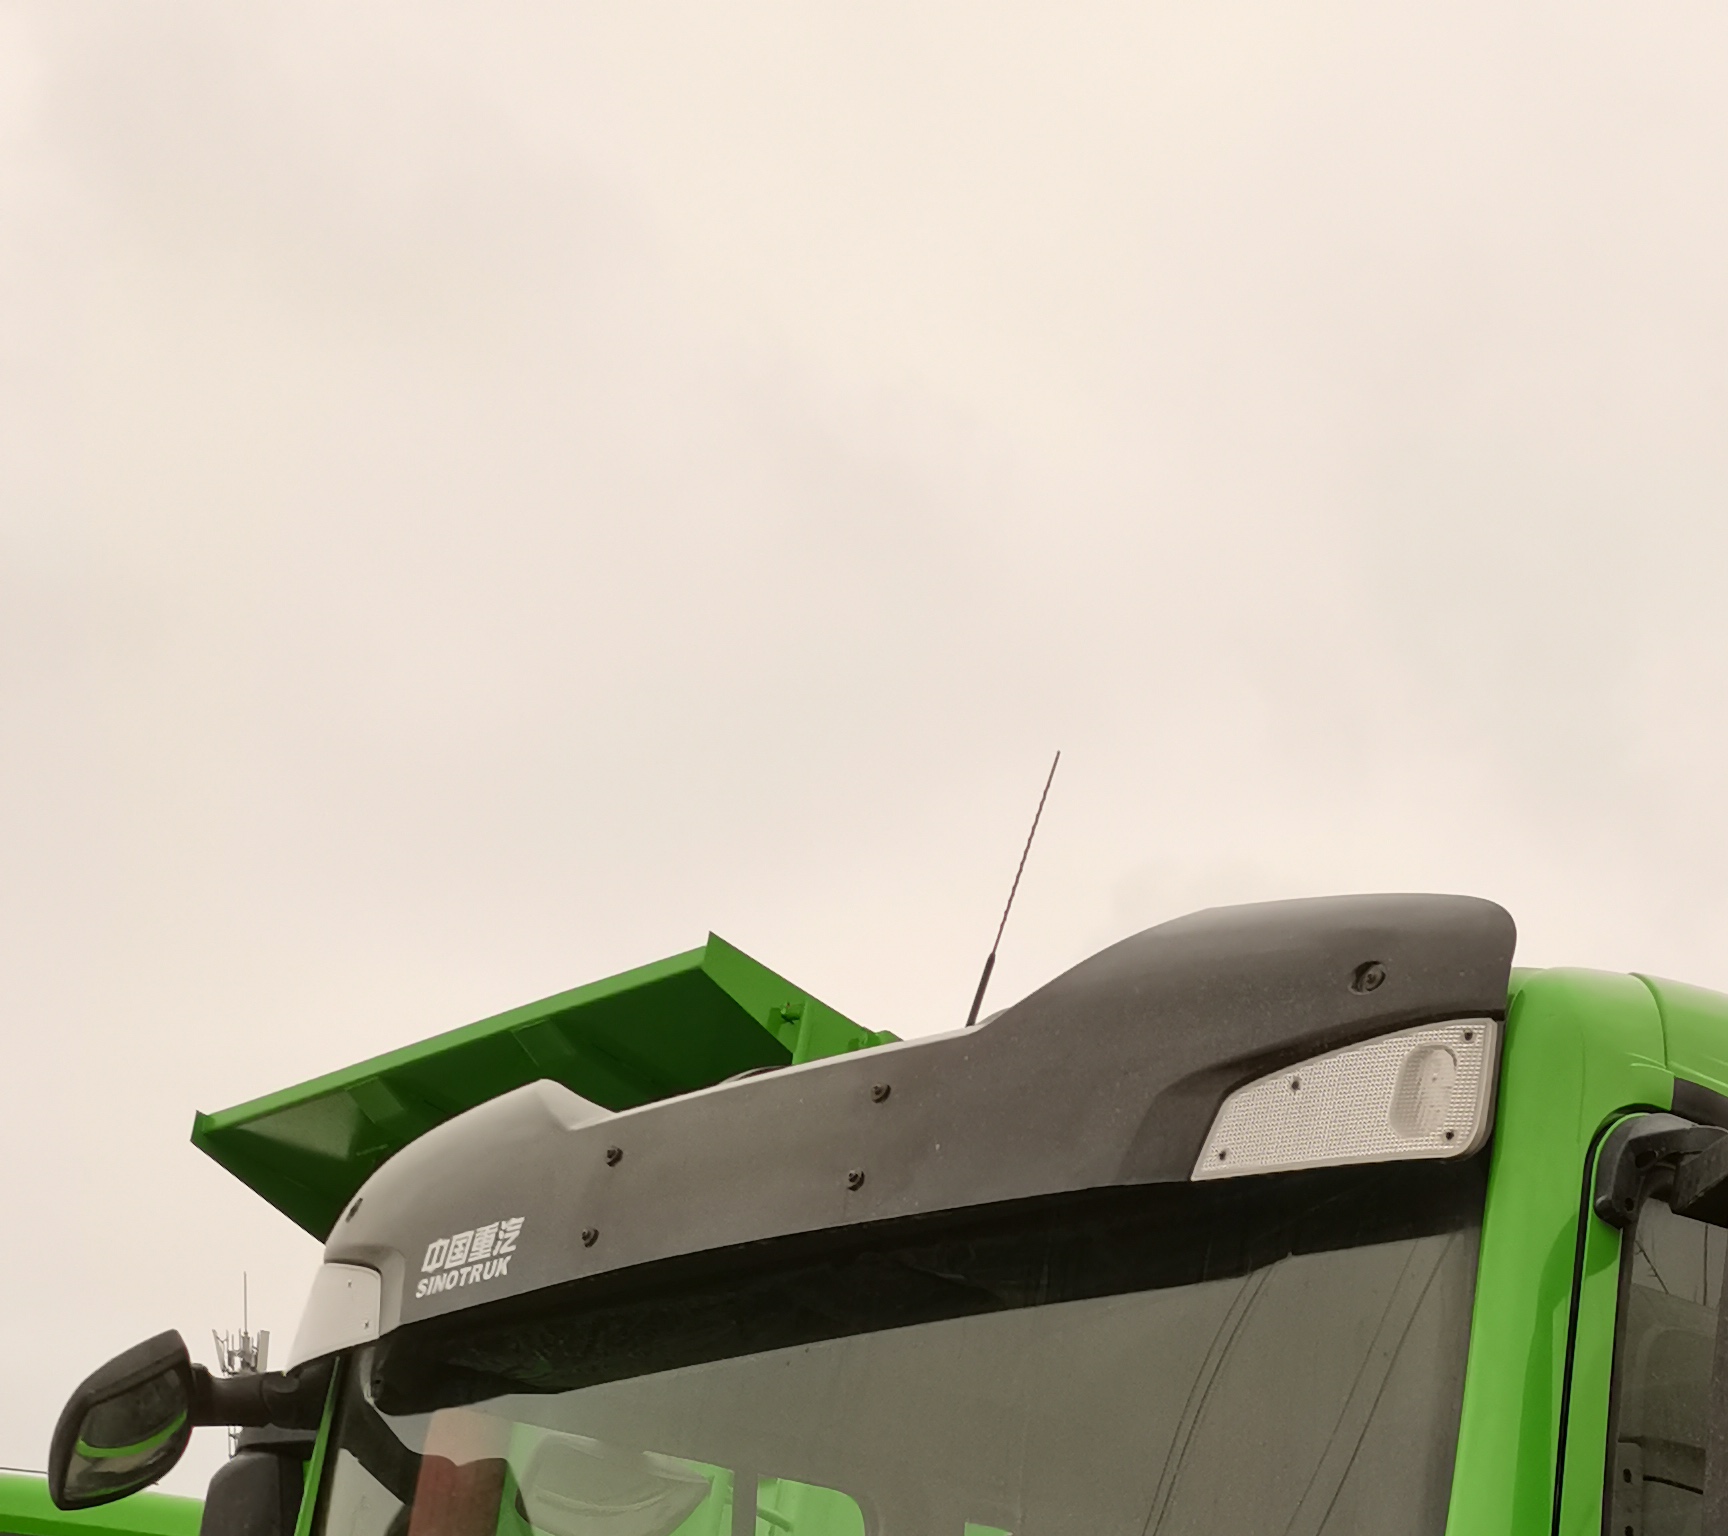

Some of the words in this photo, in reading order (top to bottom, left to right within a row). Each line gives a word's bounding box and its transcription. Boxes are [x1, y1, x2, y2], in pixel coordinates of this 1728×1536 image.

[421, 1216, 525, 1273] 中国重汽
[415, 1255, 512, 1298] SINOTRUK
